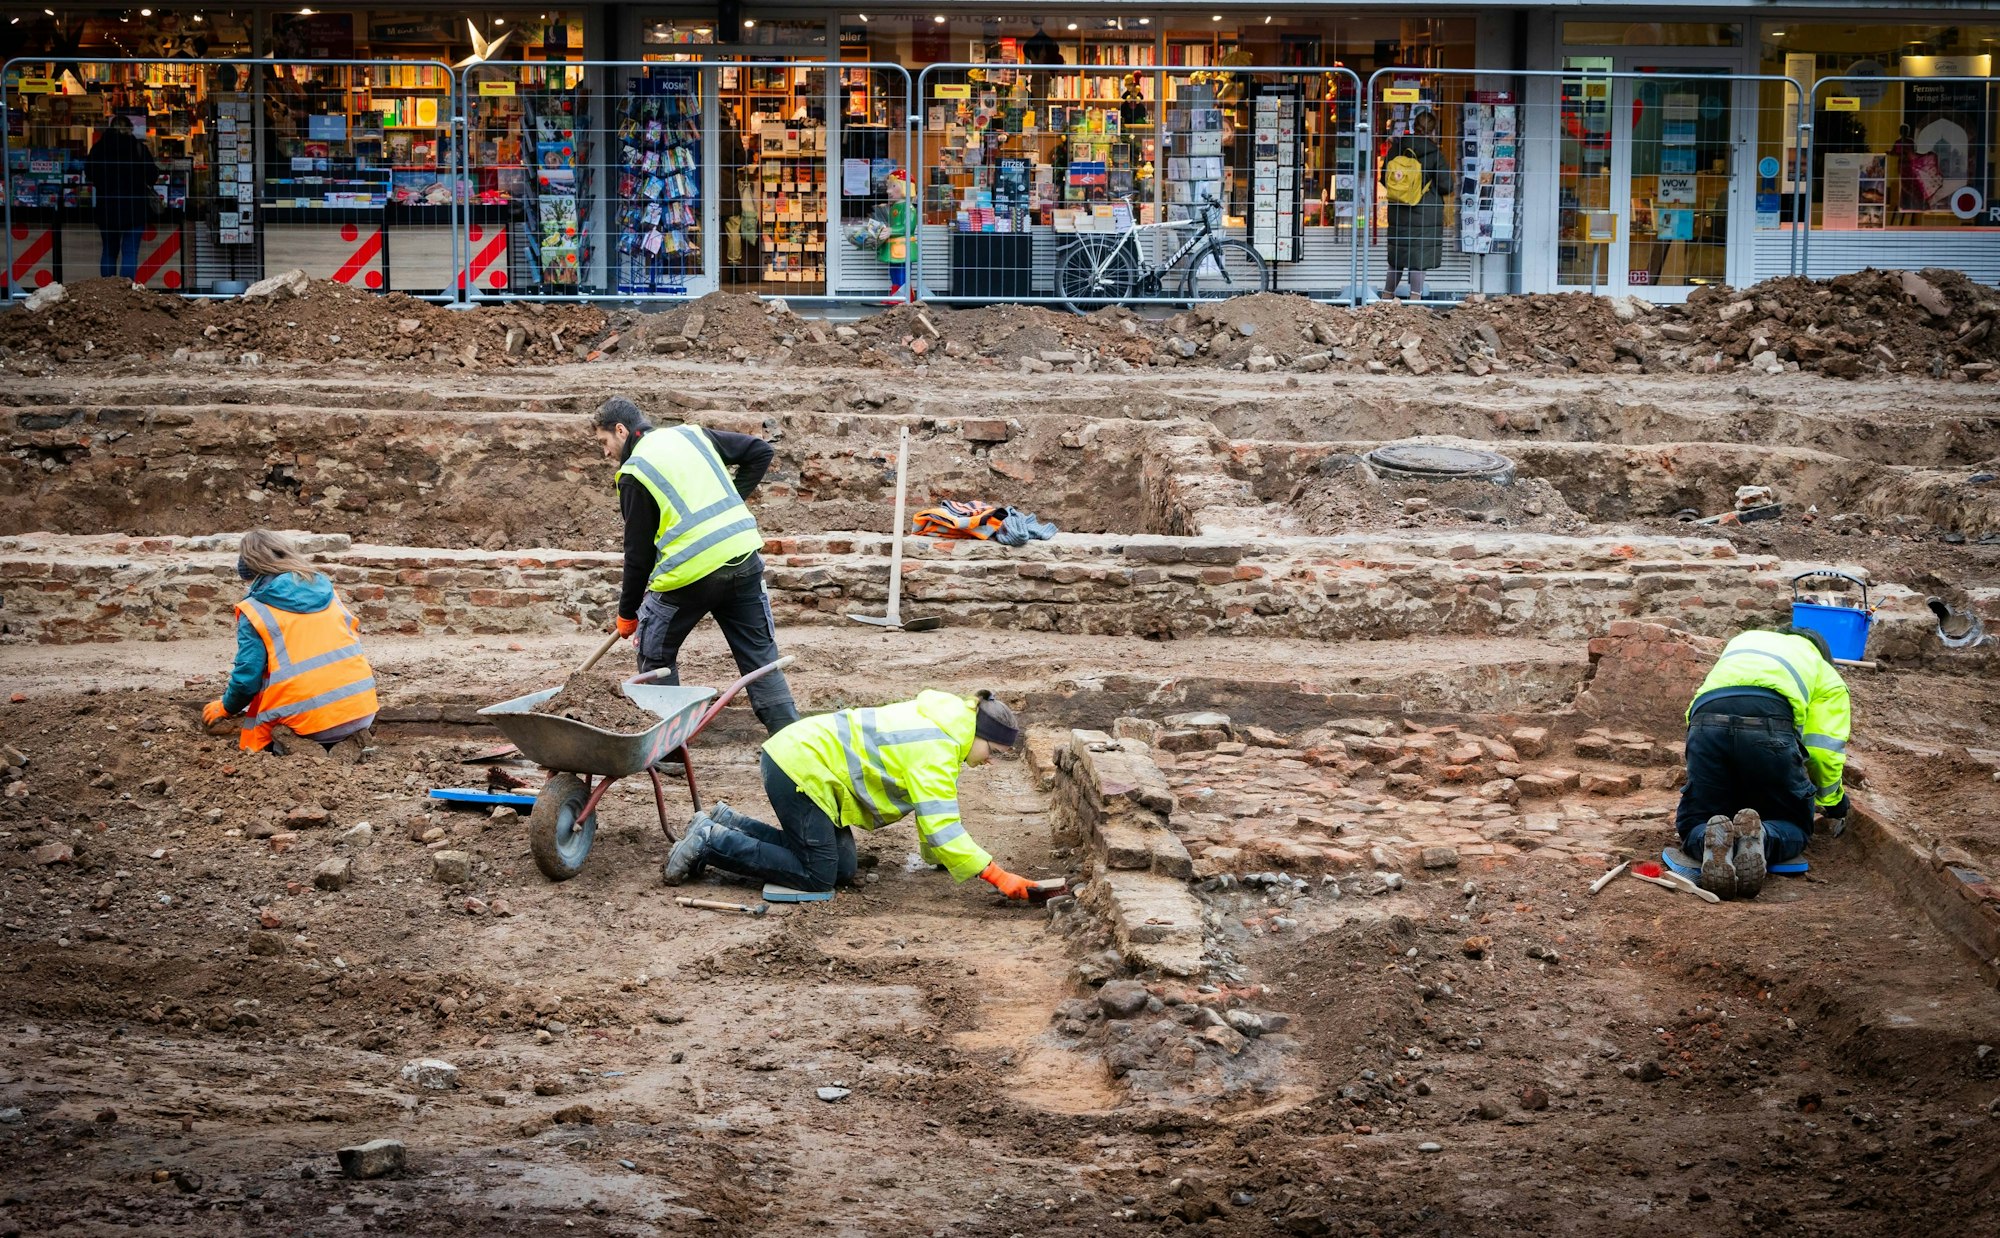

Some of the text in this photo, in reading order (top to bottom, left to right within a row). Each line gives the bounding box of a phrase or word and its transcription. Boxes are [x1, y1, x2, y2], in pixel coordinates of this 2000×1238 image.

[1916, 94, 1940, 103] bringt
[1001, 160, 1025, 168] FITZEK
[1662, 179, 1688, 187] WOW
[1165, 237, 1196, 271] STEVENS
[1631, 271, 1648, 283] DB
